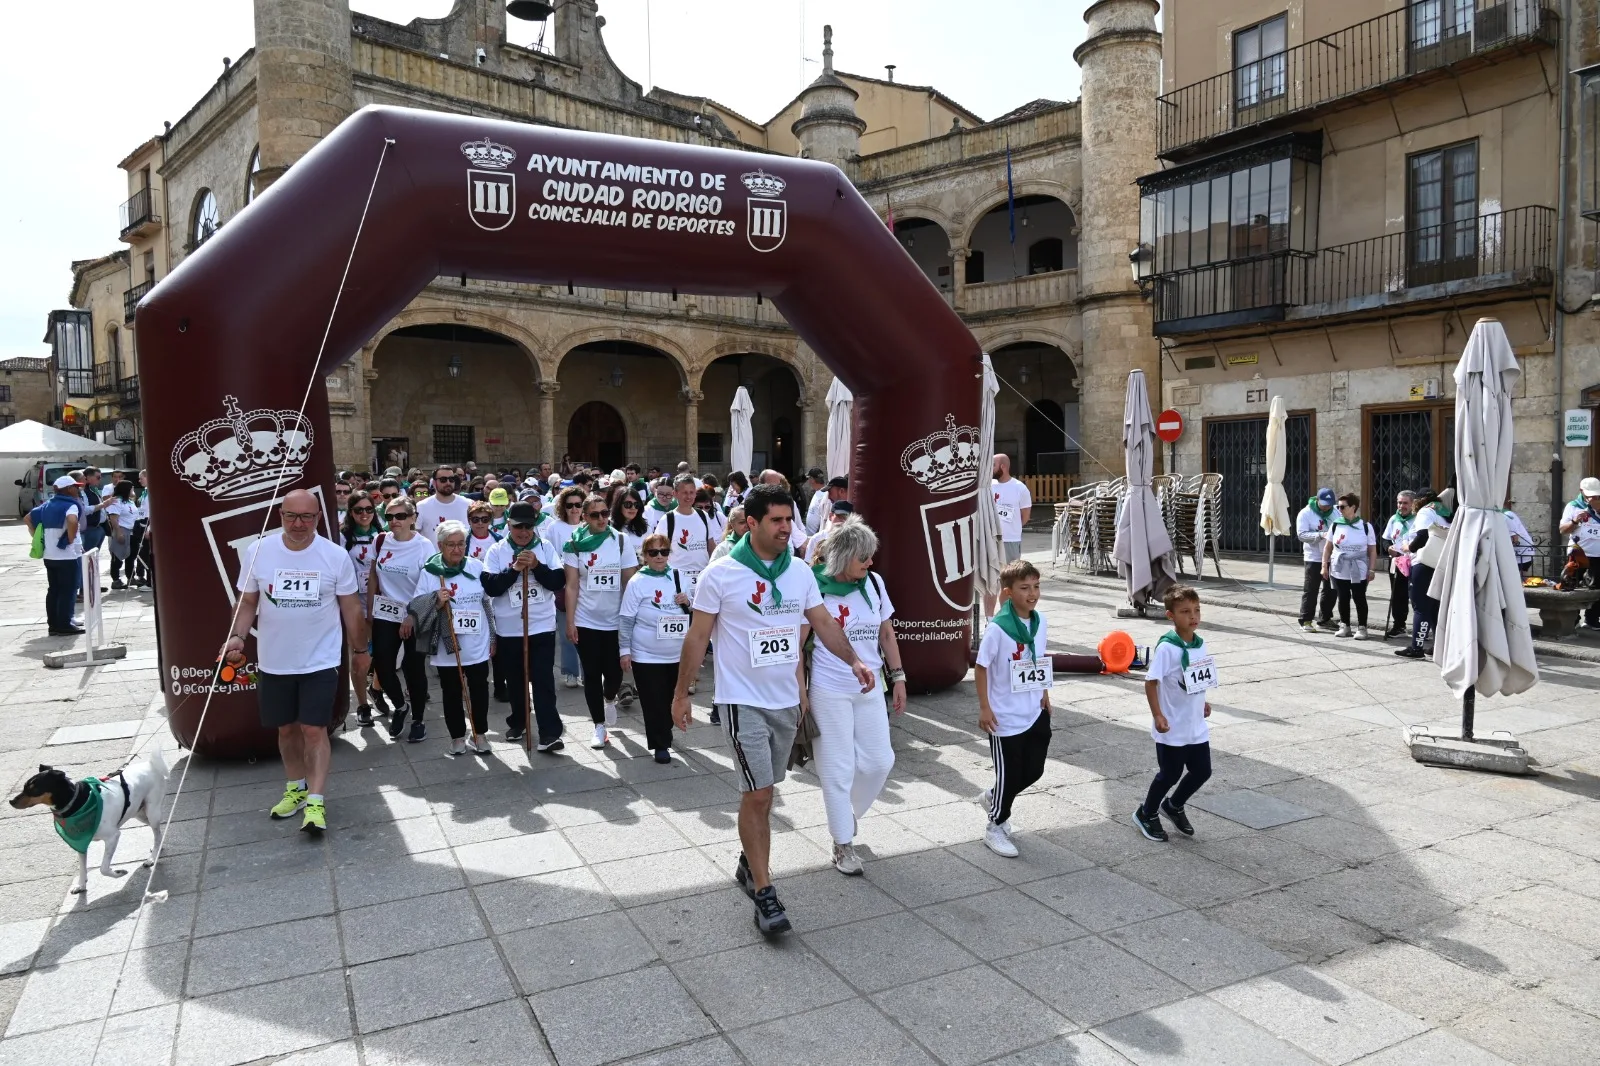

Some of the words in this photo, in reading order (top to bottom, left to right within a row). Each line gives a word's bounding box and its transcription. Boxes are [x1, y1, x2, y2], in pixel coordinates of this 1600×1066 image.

[527, 153, 694, 188] AYUNTAMIENTO
[700, 172, 726, 191] DE
[542, 179, 625, 206] CIUDAD
[631, 192, 722, 216] RODRIGO
[528, 203, 627, 228] CONCEJALIA
[631, 212, 652, 229] DE
[656, 215, 736, 236] DEPORTES
[282, 579, 310, 591] 211
[593, 575, 614, 585] 151
[380, 603, 400, 615] 225
[457, 618, 477, 628] 130
[662, 623, 684, 633] 150
[1415, 621, 1429, 647] didas
[760, 638, 790, 655] 203
[1018, 669, 1046, 683] 143
[1190, 667, 1212, 683] 144
